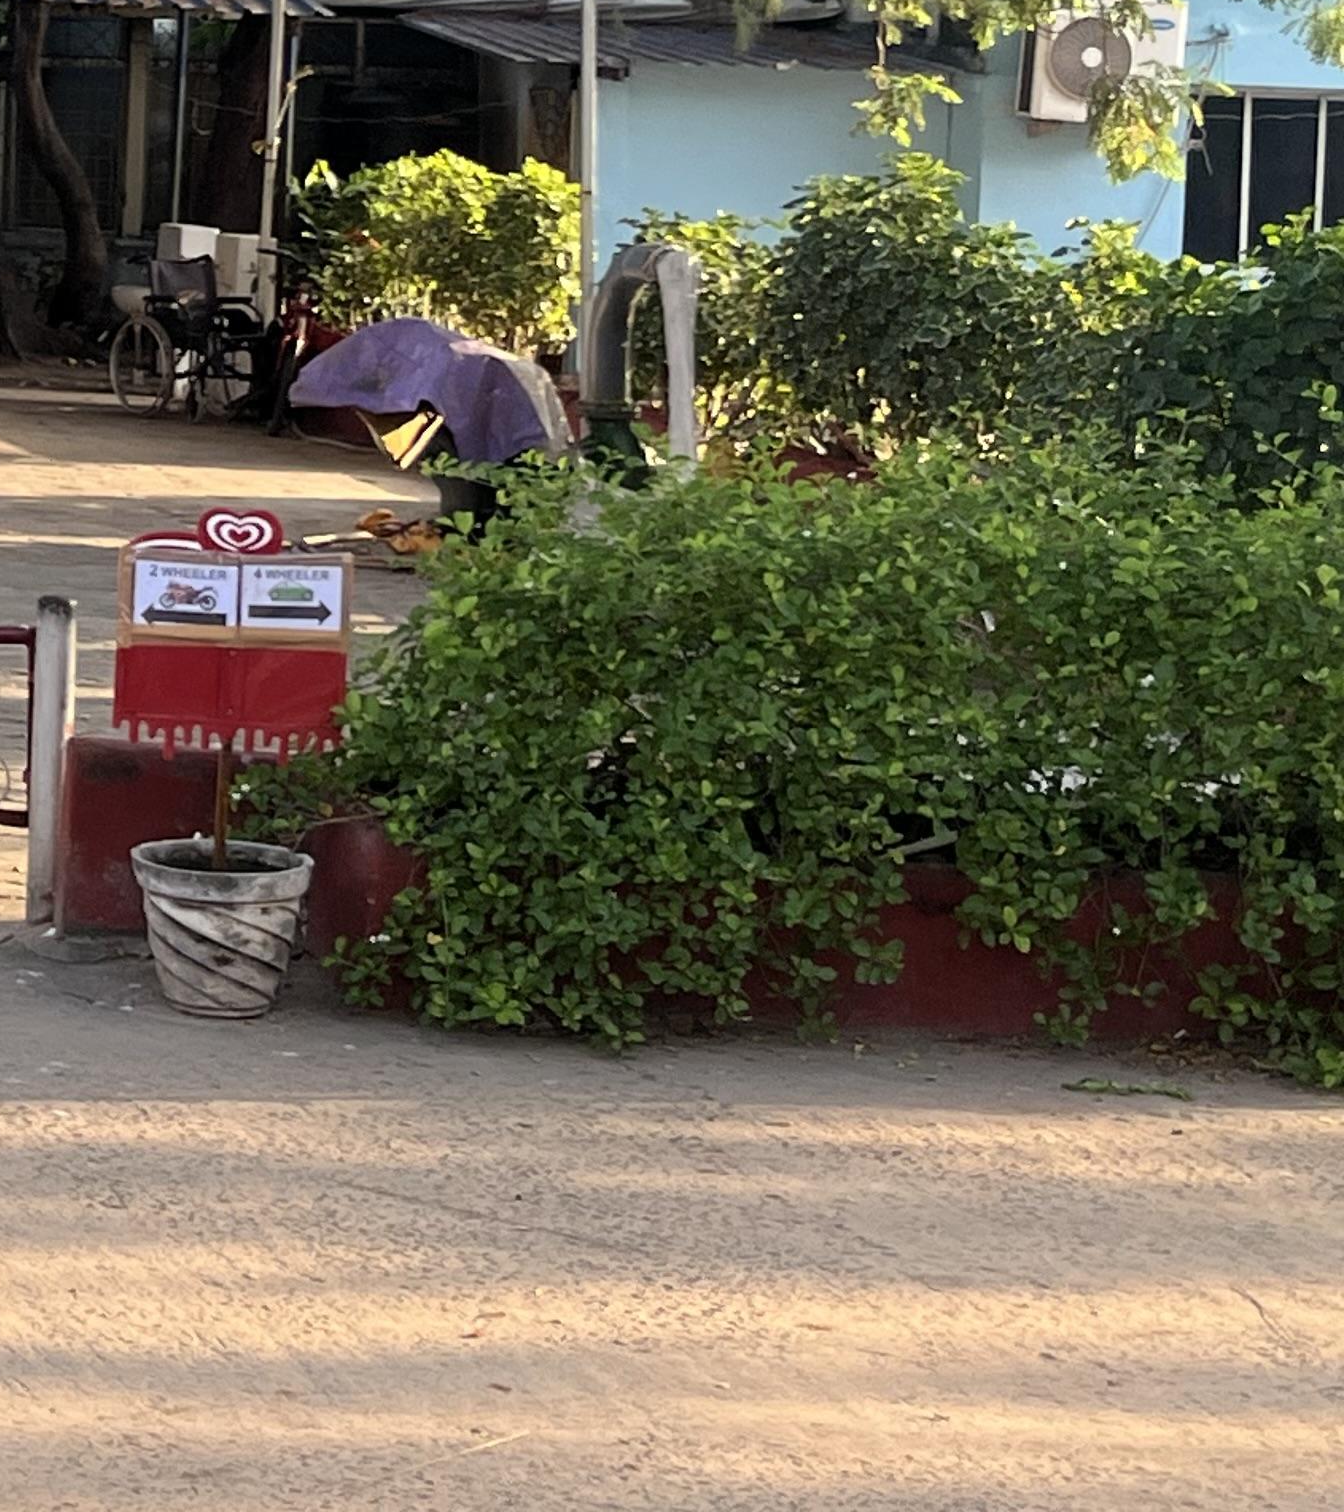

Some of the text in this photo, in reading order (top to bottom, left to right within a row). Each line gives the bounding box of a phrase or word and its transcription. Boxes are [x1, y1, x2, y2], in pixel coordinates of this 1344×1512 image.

[149, 564, 227, 580] 2 WHEELER
[254, 568, 330, 581] 4 WHEELER
